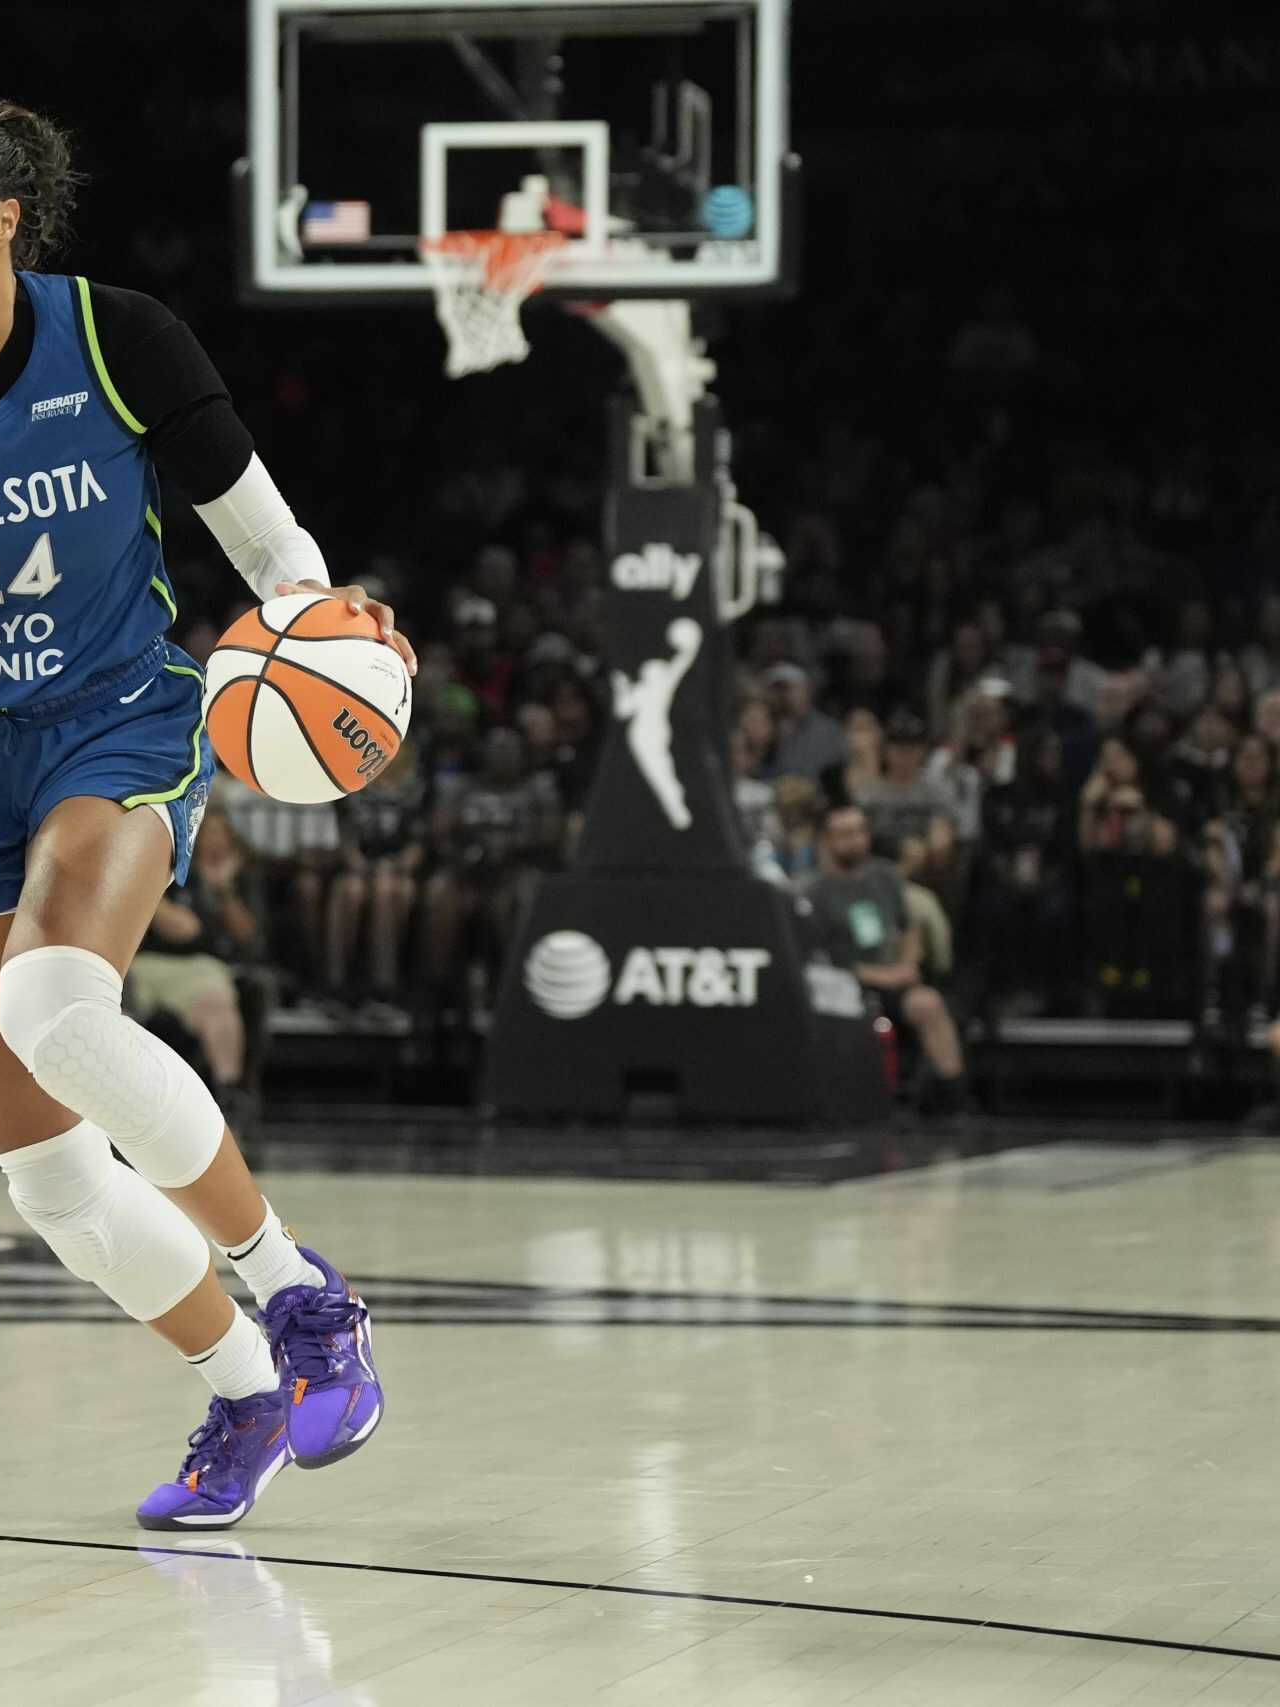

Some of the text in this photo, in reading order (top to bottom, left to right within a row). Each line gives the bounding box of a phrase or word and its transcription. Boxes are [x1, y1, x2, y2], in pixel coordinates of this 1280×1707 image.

[31, 391, 88, 414] FEDERATED
[611, 543, 702, 600] ally
[332, 706, 392, 784] ilson
[615, 947, 771, 1006] AT&T
